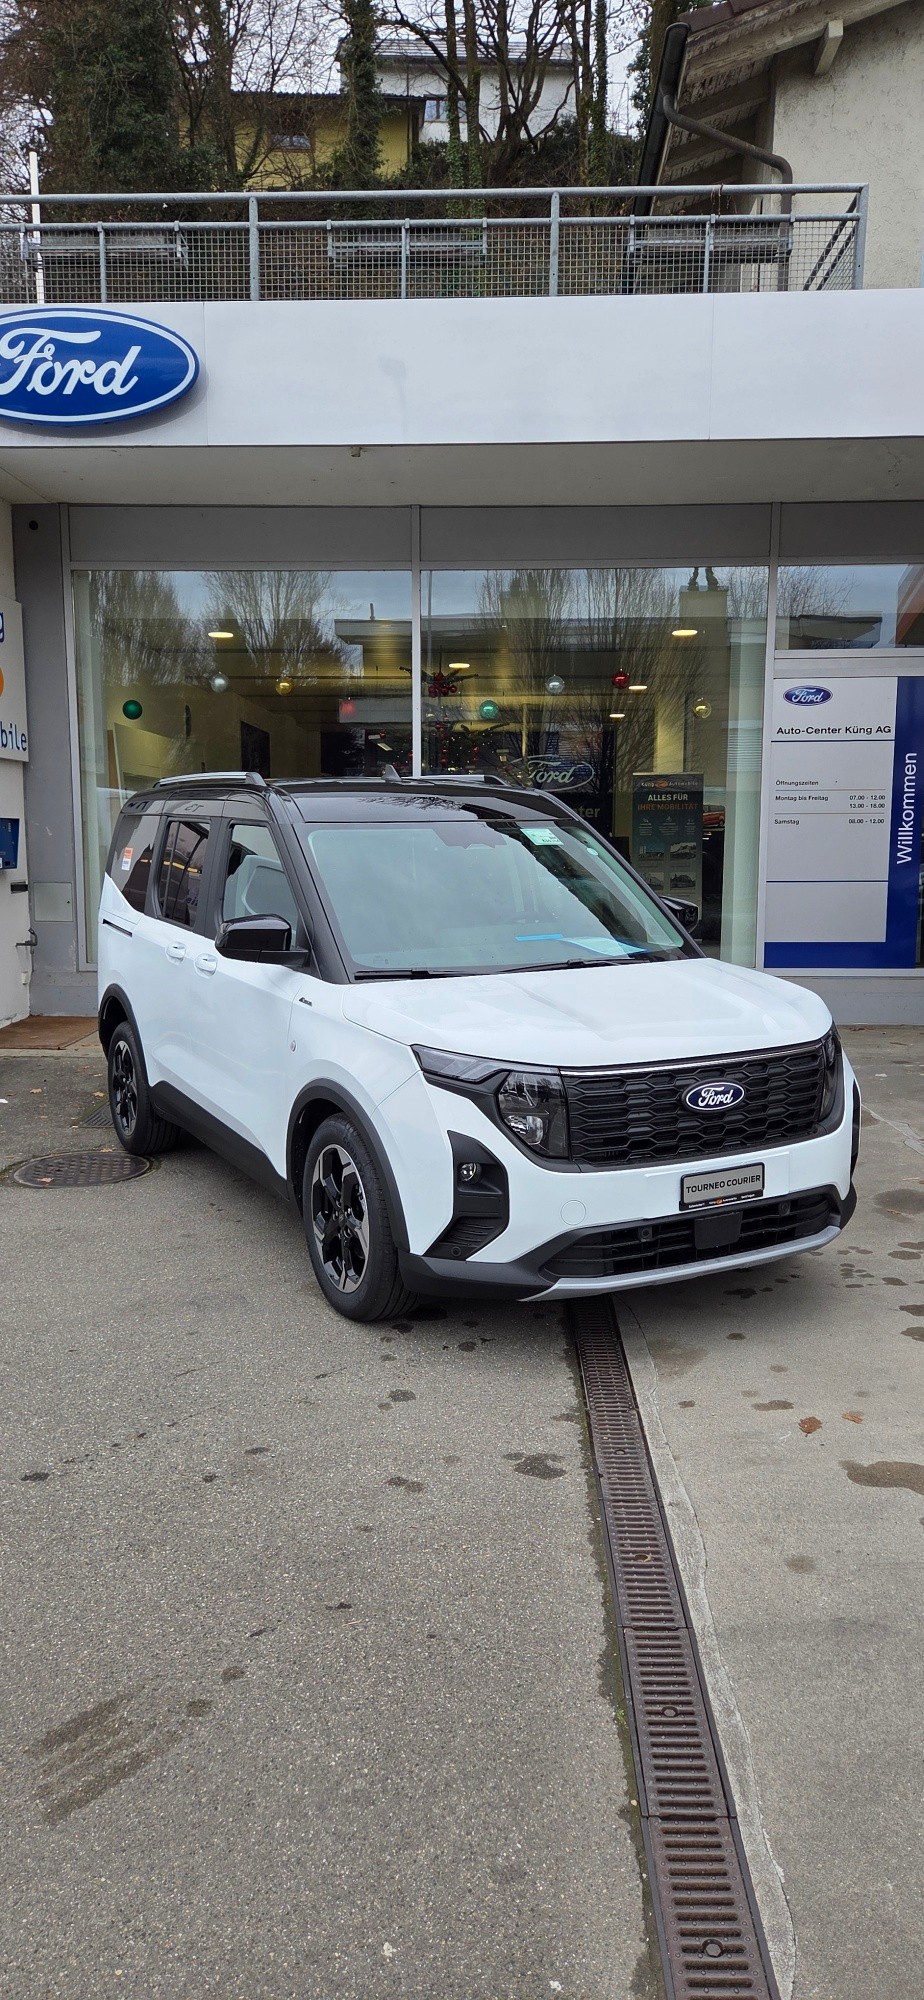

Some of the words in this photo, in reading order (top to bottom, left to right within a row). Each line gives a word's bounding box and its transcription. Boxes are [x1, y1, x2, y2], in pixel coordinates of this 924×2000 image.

[0, 328, 141, 395] Ford
[791, 685, 824, 704] Ford
[777, 727, 842, 735] Auto-Center
[845, 726, 872, 735] Küng
[527, 760, 576, 783] Ford
[673, 793, 688, 801] FÜR
[896, 752, 918, 865] Willkommen
[698, 1086, 734, 1106] Ford
[686, 1181, 725, 1193] TOURNEO
[727, 1175, 761, 1186] COURIER
